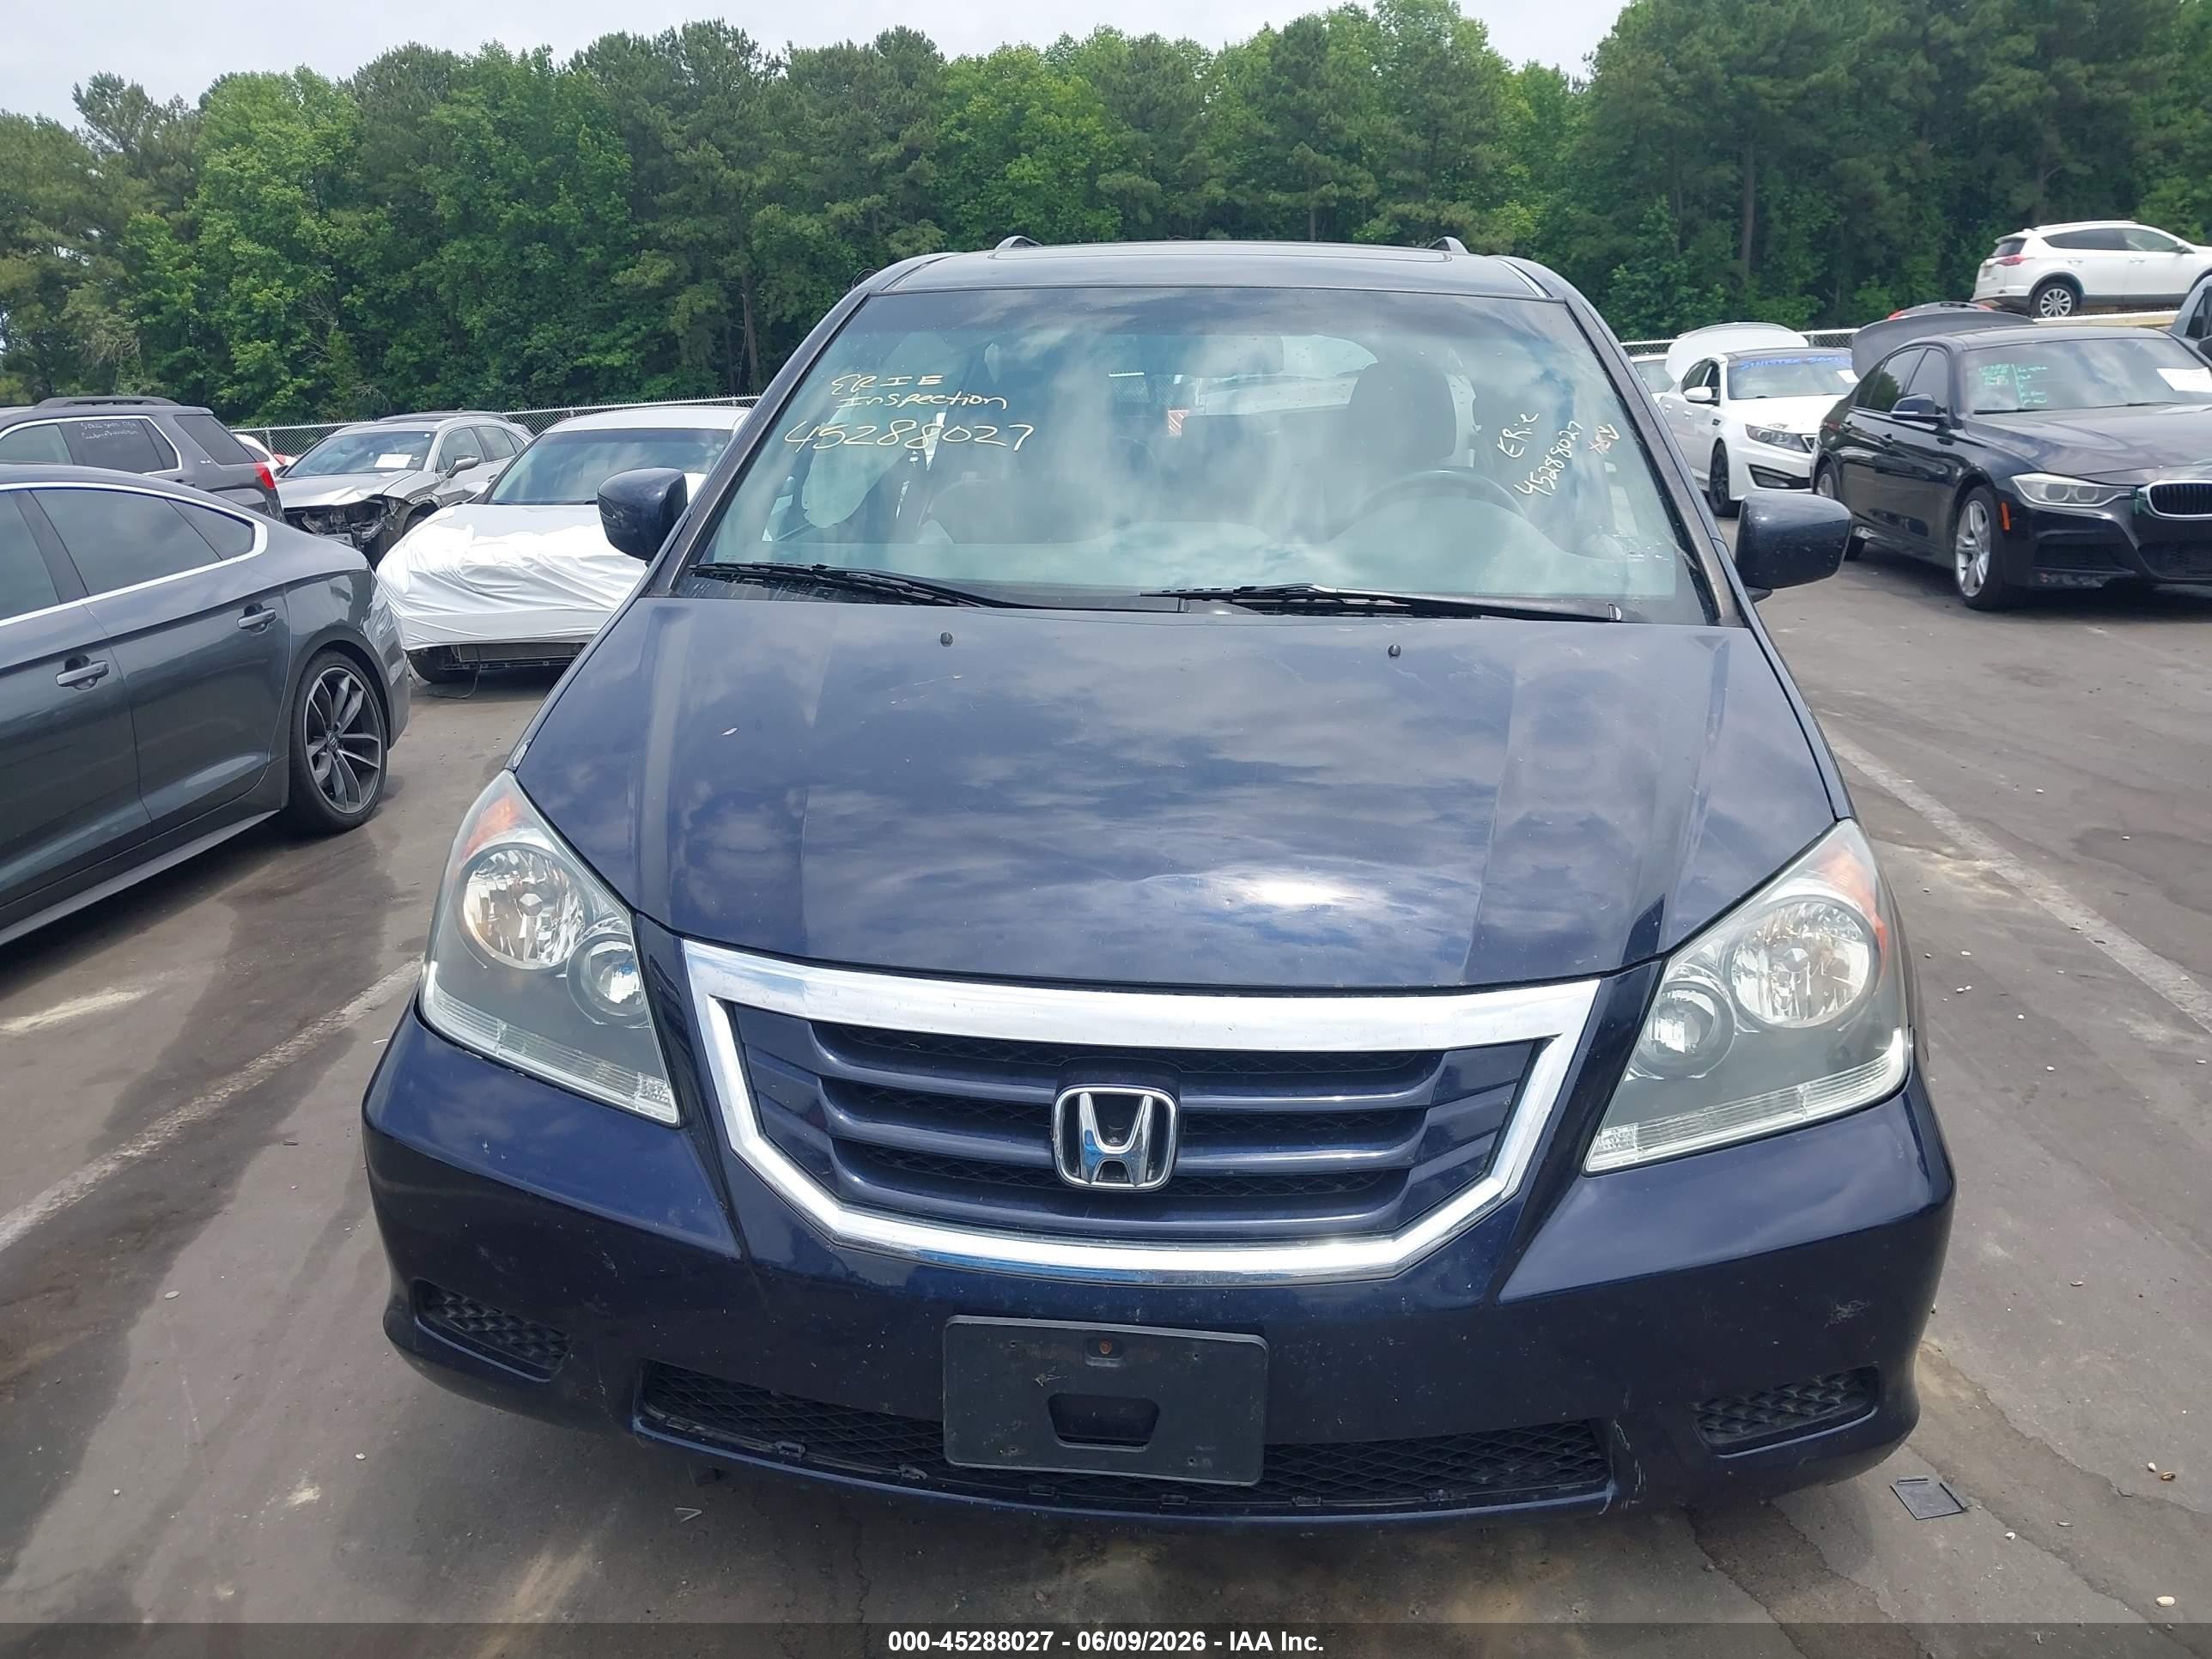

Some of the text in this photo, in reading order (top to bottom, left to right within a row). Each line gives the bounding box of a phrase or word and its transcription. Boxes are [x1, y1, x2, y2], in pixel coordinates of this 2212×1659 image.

[836, 390, 1008, 410] Inspection
[783, 419, 1036, 453] 45288027
[1514, 420, 1583, 497] 45288027
